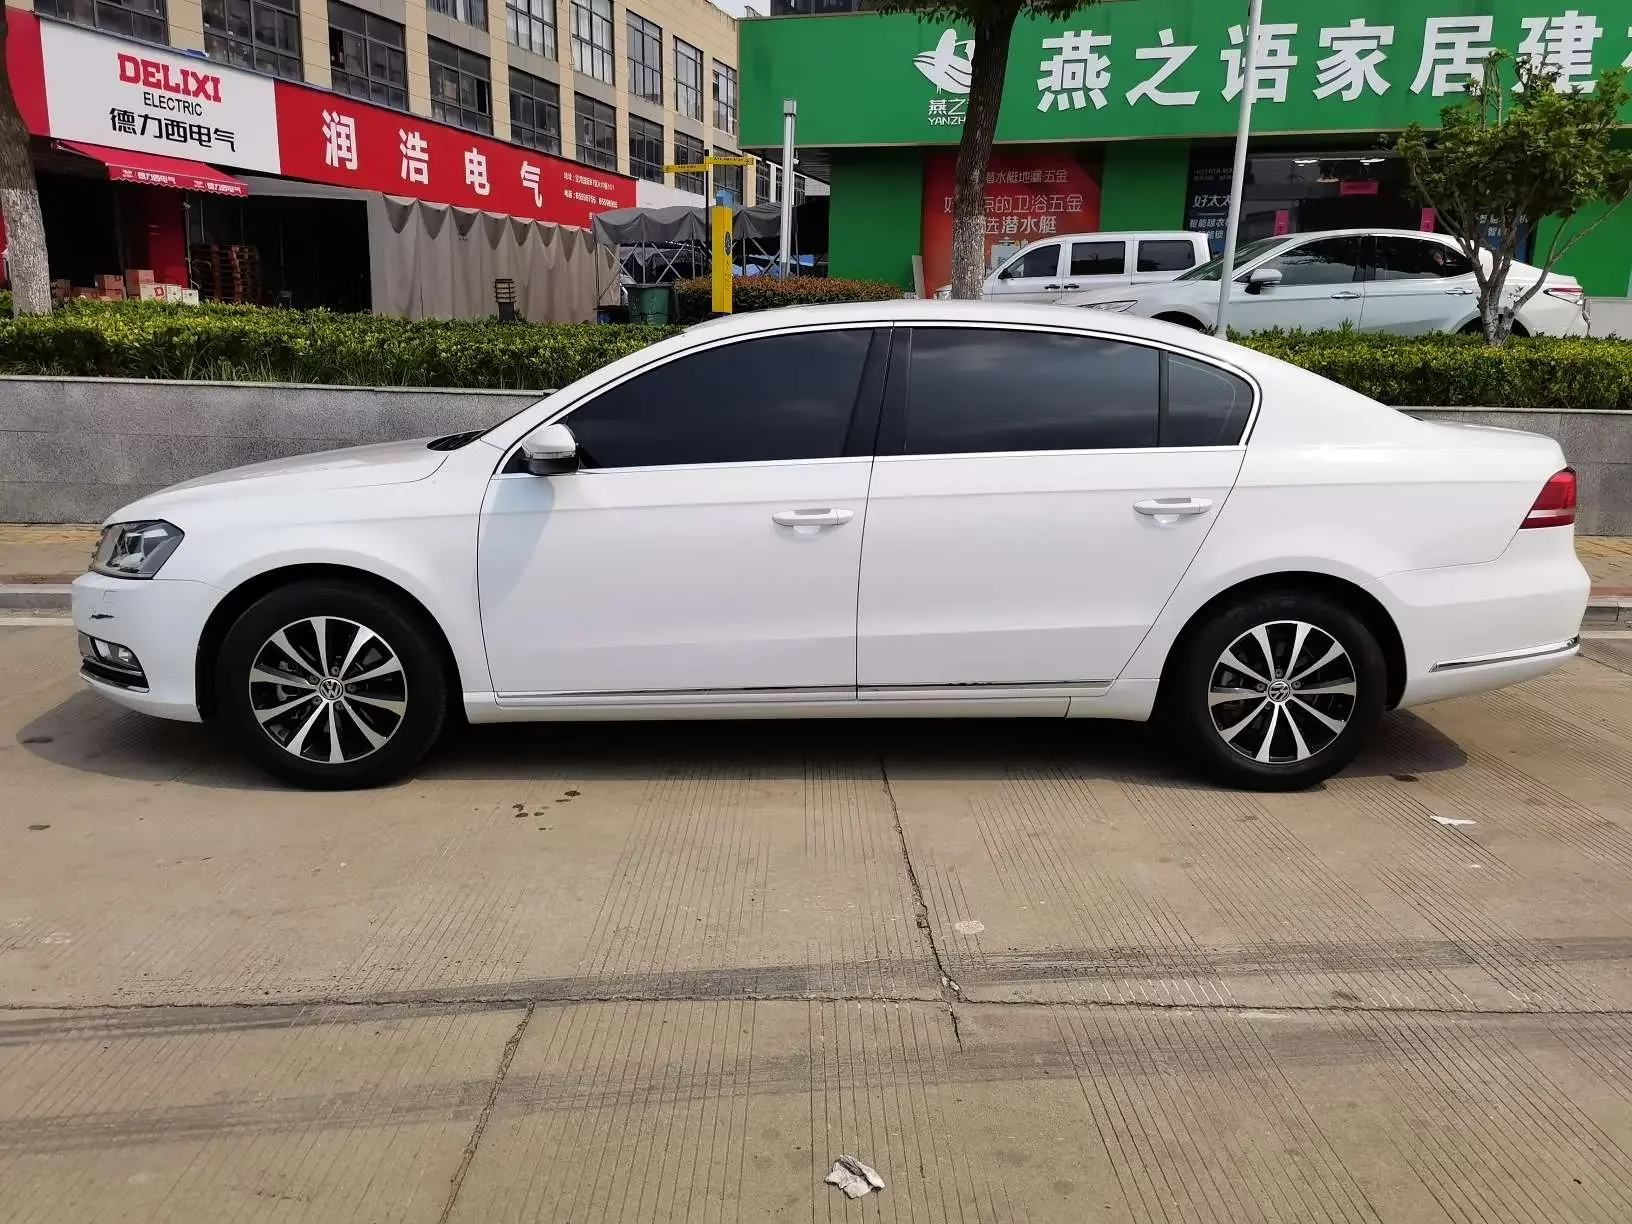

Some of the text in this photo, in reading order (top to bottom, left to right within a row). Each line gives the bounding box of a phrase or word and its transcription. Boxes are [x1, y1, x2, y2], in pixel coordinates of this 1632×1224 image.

[117, 53, 222, 103] DELIXI
[1037, 10, 1632, 113] 燕之语家居建
[143, 92, 203, 116] ELECTRIC
[928, 98, 969, 115] 燕之
[109, 107, 236, 152] 德力西电气
[322, 110, 543, 208] 润浩电气
